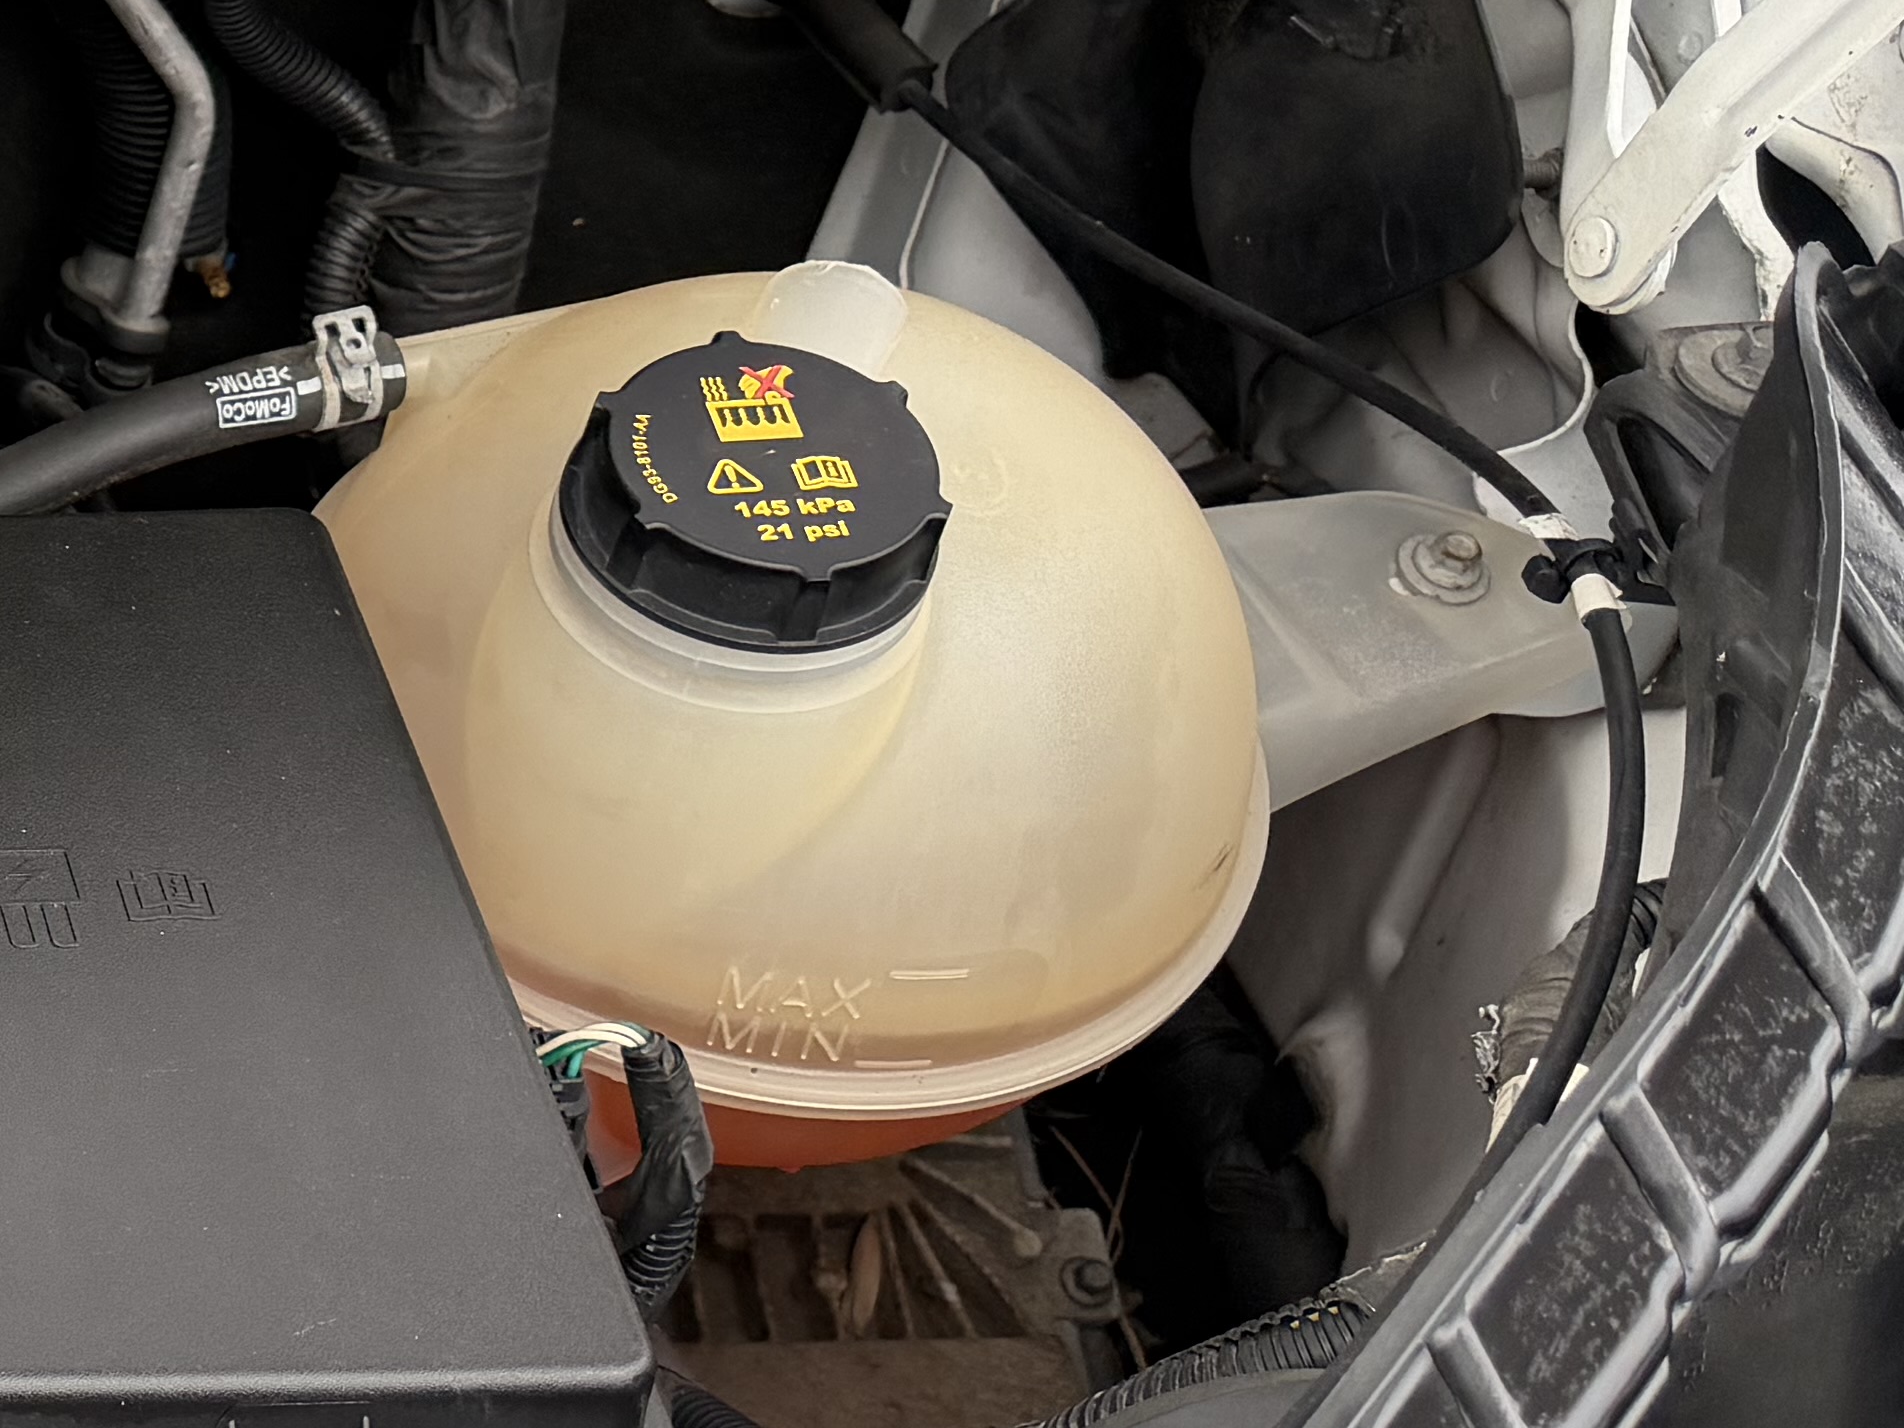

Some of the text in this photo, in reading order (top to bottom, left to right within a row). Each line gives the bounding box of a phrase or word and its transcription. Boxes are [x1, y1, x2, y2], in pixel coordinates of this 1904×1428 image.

[220, 395, 294, 425] FoMoCo
[733, 497, 857, 520] 145 kPa
[757, 520, 851, 544] 21 psi
[717, 965, 873, 1019] MAX
[706, 1011, 850, 1062] MIN
